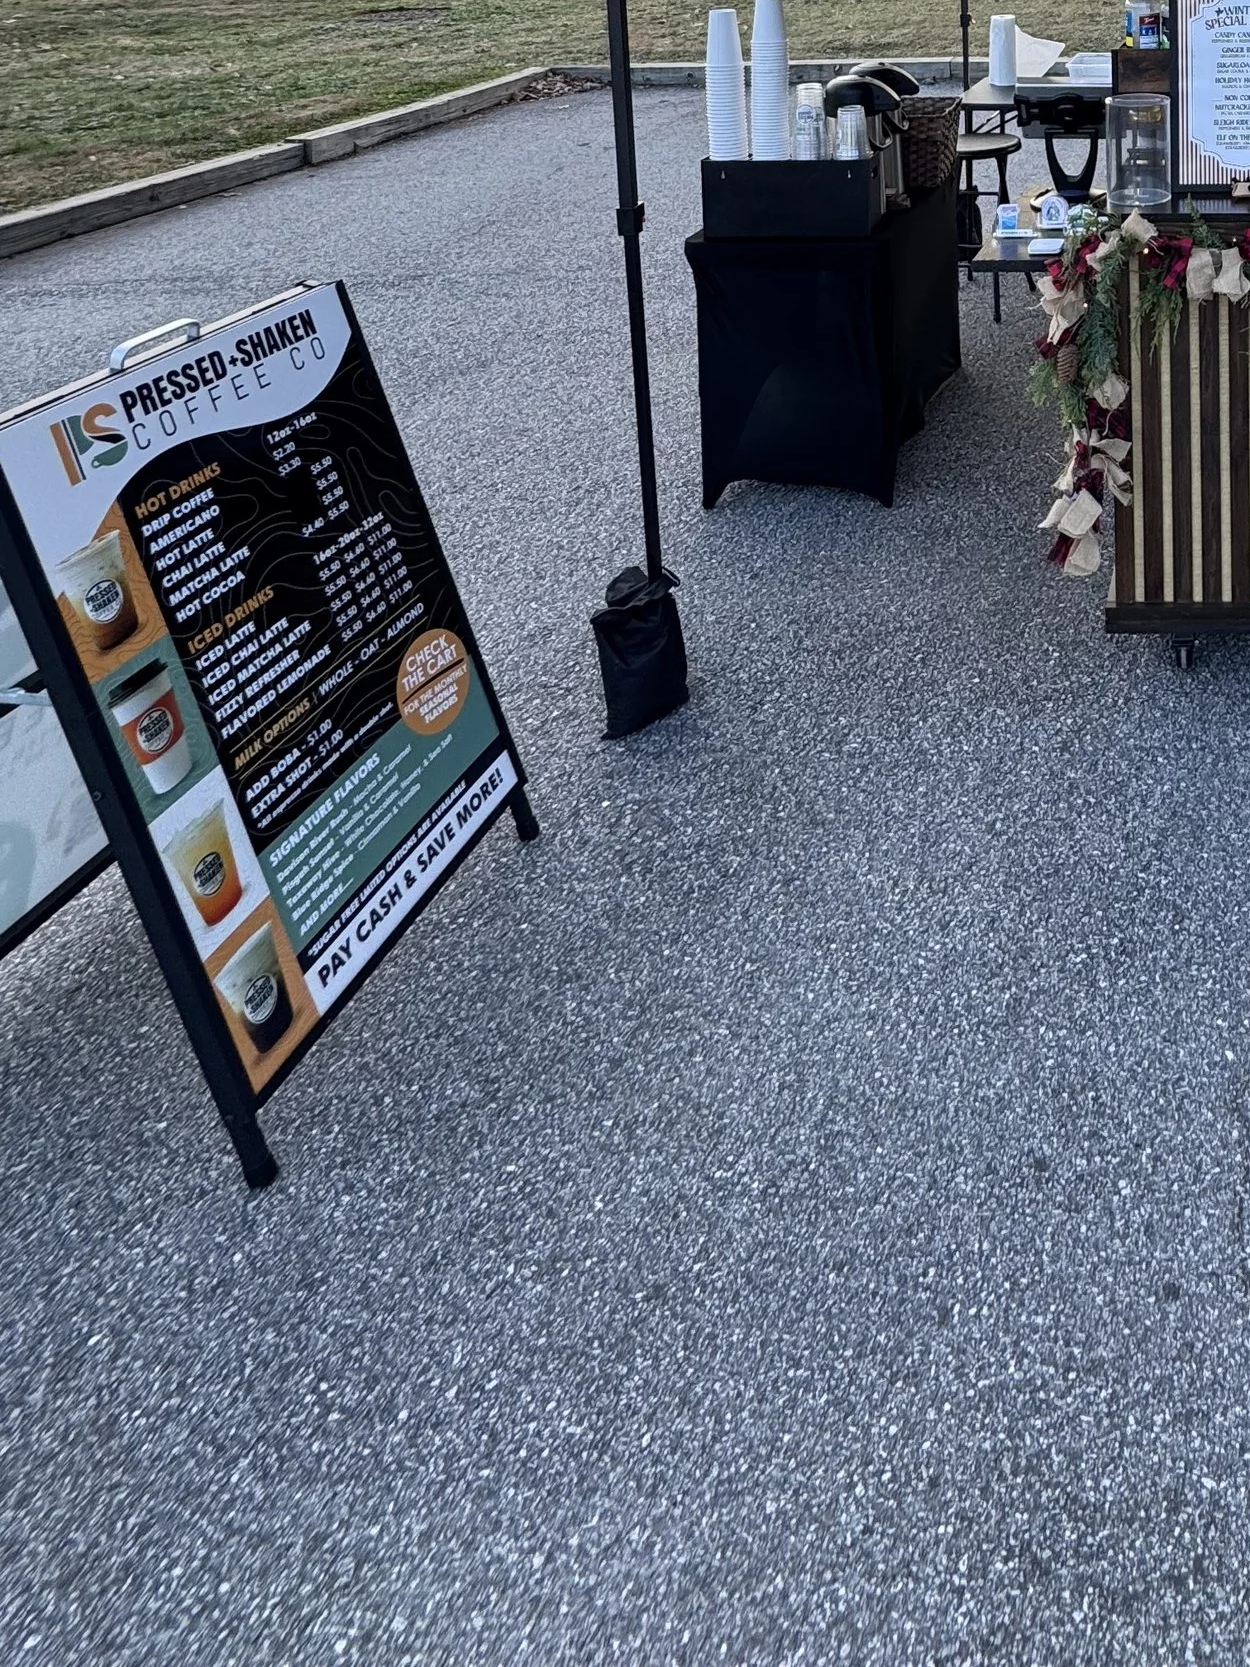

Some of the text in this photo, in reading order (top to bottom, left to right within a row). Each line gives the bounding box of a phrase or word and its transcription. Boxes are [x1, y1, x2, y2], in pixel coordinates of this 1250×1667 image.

[1205, 16, 1247, 30] SPECIAL
[132, 336, 325, 450] COFFEE CO
[135, 492, 166, 519] HOT
[169, 463, 221, 499] DRINKS
[142, 443, 295, 536] DRIP COFFEE $2.20
[151, 457, 301, 554] AMERICANO $3.30
[156, 457, 332, 571] HOT LATTE $5.50
[163, 472, 338, 587] CHAI LATTE $5.50
[170, 487, 343, 606] MATCHA LATTE $5.50
[176, 599, 201, 622] HOT
[203, 572, 245, 604] COCOA
[328, 501, 349, 520] $5.50
[196, 646, 224, 670] ICED
[225, 622, 256, 649] LATTE
[319, 561, 341, 581] $5.50
[368, 524, 392, 545] $11.00
[188, 624, 223, 654] ICED
[225, 586, 274, 628] DRINKS
[202, 663, 230, 688] ICED
[231, 640, 259, 665] CHAI
[260, 618, 289, 644] LATTE
[325, 576, 346, 596] $5.50
[373, 538, 397, 560] $11.00
[209, 680, 236, 705] ICED
[238, 644, 283, 683] MATCHA
[283, 621, 311, 647] LATTE
[331, 591, 352, 611] $5.50
[379, 553, 402, 574] $11.00
[215, 693, 244, 722] FIZZY
[245, 650, 300, 698] REFRESHER
[336, 606, 357, 626] $5.50
[384, 567, 407, 589] $11.00
[222, 690, 276, 739] FLAVORED
[277, 645, 331, 693] LEMONADE
[342, 621, 362, 641] $5.50
[389, 581, 412, 603] $11.00
[406, 634, 449, 672] CHECK
[236, 604, 424, 770] MILK OPTIONS WHOLE OAT ALMOND
[402, 644, 456, 692] THE CART
[404, 664, 467, 716] FOR THE MONTHLY
[419, 682, 458, 716] SEASONAL
[424, 693, 458, 724] FLAVORS
[247, 720, 332, 801] ADD BOBA $1.00
[252, 730, 343, 818] EXTRA SHOT $1.00
[270, 754, 380, 867] SIGNATURE FLAVORS
[273, 789, 301, 818] espresso
[302, 769, 322, 789] drinks
[322, 752, 340, 770] made
[340, 739, 354, 753] with
[318, 767, 504, 988] PAY CASH & SAVE MORE!
[341, 898, 360, 923] FREE
[386, 835, 417, 872] OPTIONS
[418, 819, 431, 838] ARE
[432, 781, 466, 822] AVAILABLE
[301, 911, 319, 936] AND
